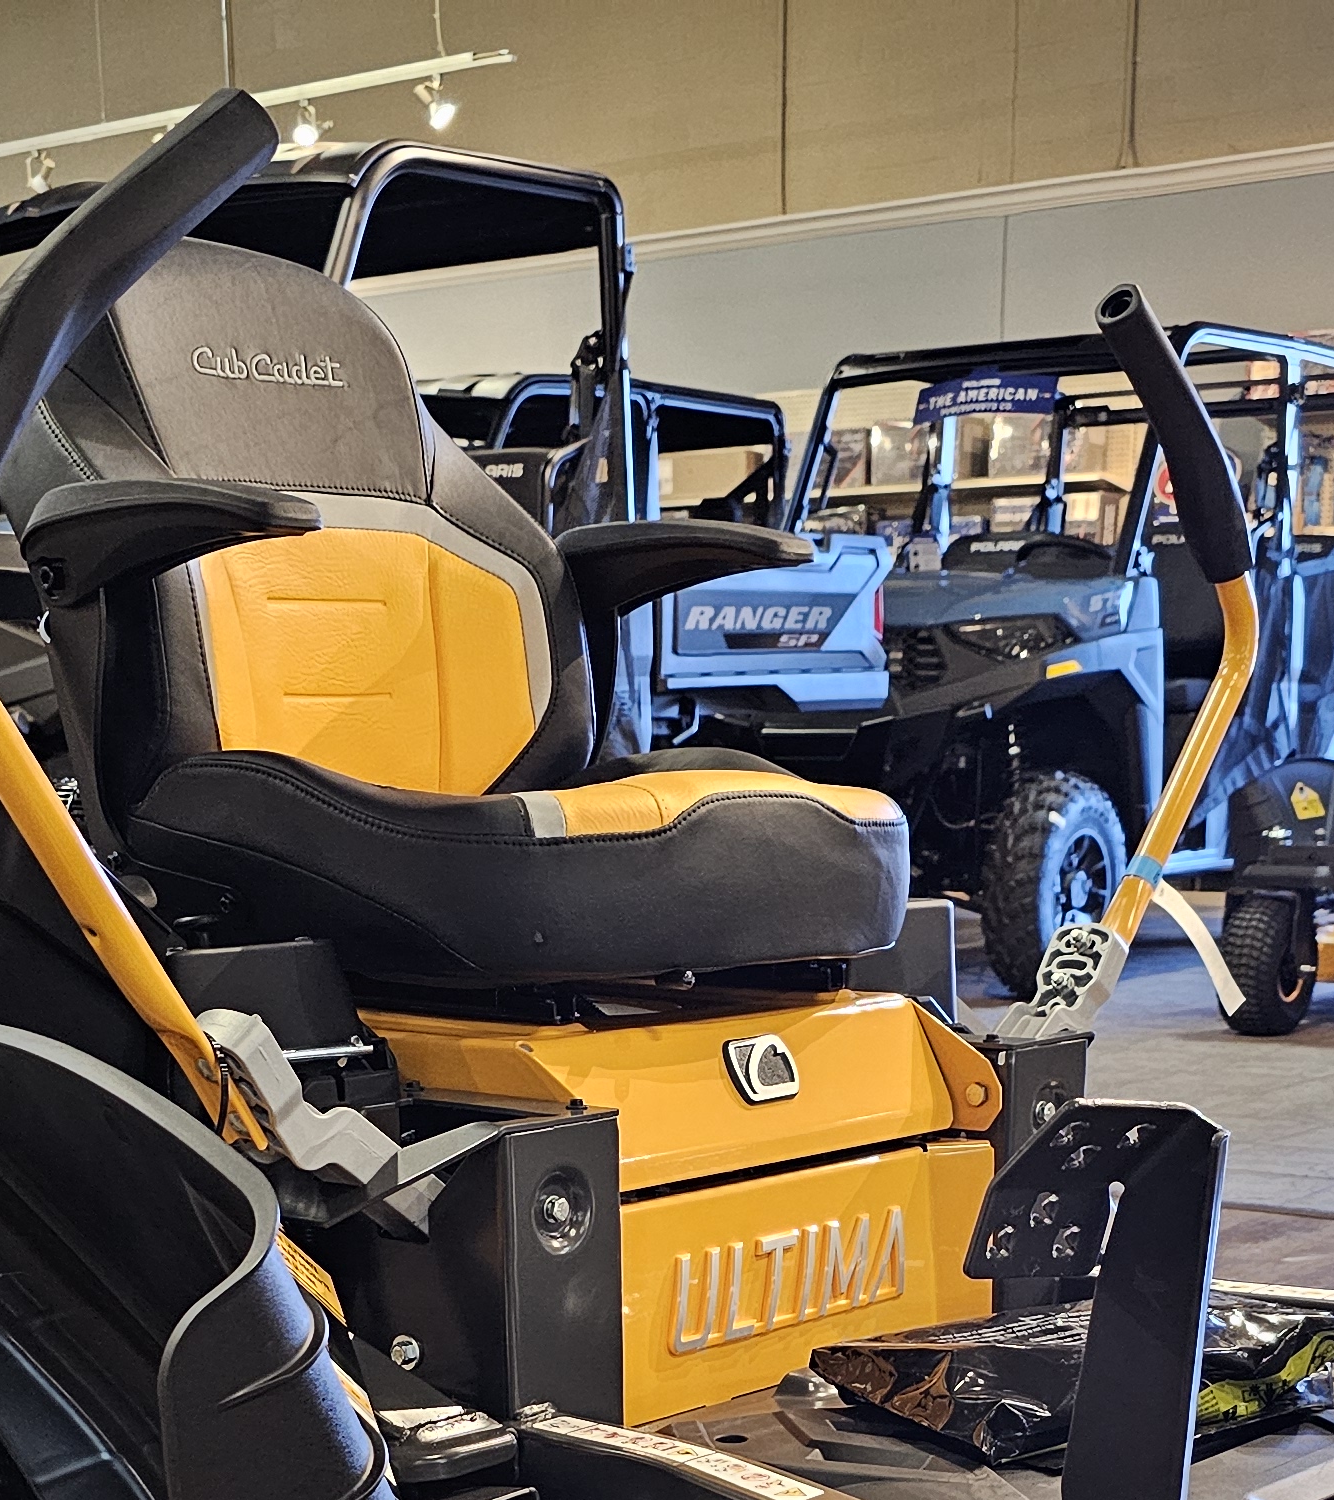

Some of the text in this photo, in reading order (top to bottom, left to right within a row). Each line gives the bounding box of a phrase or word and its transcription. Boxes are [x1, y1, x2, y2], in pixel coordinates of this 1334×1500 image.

[191, 345, 344, 388] Cub Cadet
[928, 387, 1039, 411] THE AMERICAN
[684, 605, 833, 631] RANGER
[777, 633, 820, 648] SP
[667, 1205, 906, 1357] ULTIMA
